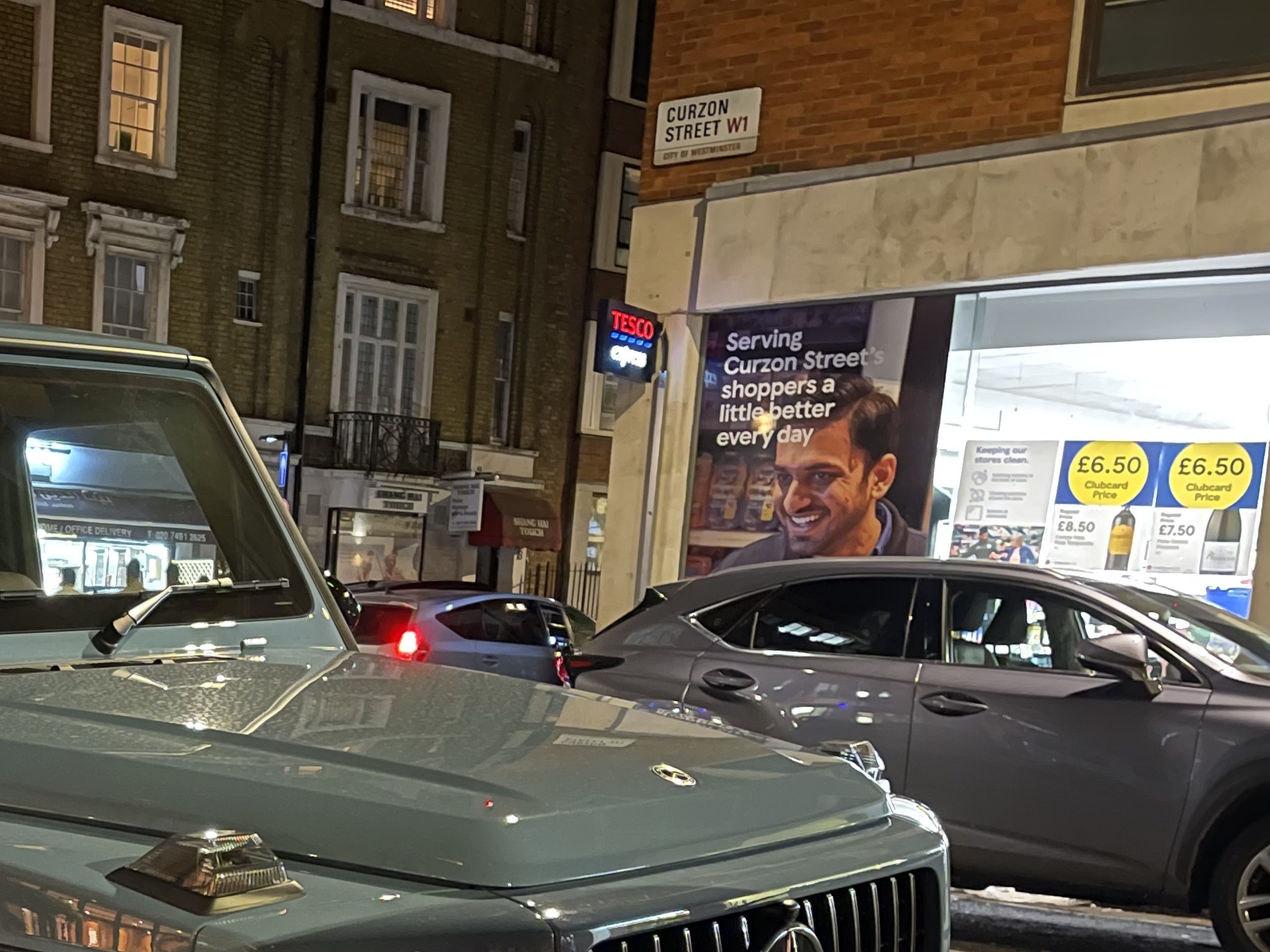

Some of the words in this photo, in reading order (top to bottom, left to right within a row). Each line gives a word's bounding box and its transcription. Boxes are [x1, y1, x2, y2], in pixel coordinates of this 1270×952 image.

[666, 98, 729, 123] CURZON
[664, 119, 722, 143] STREET
[726, 115, 749, 134] W1
[662, 150, 679, 161] CITY
[680, 150, 689, 158] OF
[691, 142, 741, 156] WESTMINSTER
[611, 309, 654, 340] TESCO
[725, 329, 803, 352] Serving
[723, 355, 797, 376] Curzon
[803, 347, 885, 370] Street's
[720, 379, 817, 402] shoppers
[821, 377, 836, 394] a
[718, 402, 765, 423] little
[768, 400, 836, 421] better
[716, 429, 775, 450] every
[776, 424, 814, 448] day
[1076, 455, 1142, 474] £6.50
[1177, 457, 1245, 476] £6.50
[1084, 480, 1129, 490] Clubcard
[1185, 482, 1232, 492] Clubcard
[1092, 490, 1118, 500] Price
[1194, 492, 1221, 502] Price
[64, 524, 93, 536] OFFICE
[94, 526, 132, 538] DELIVERY
[1056, 520, 1096, 533] £8.50
[1158, 524, 1196, 537] £7.50
